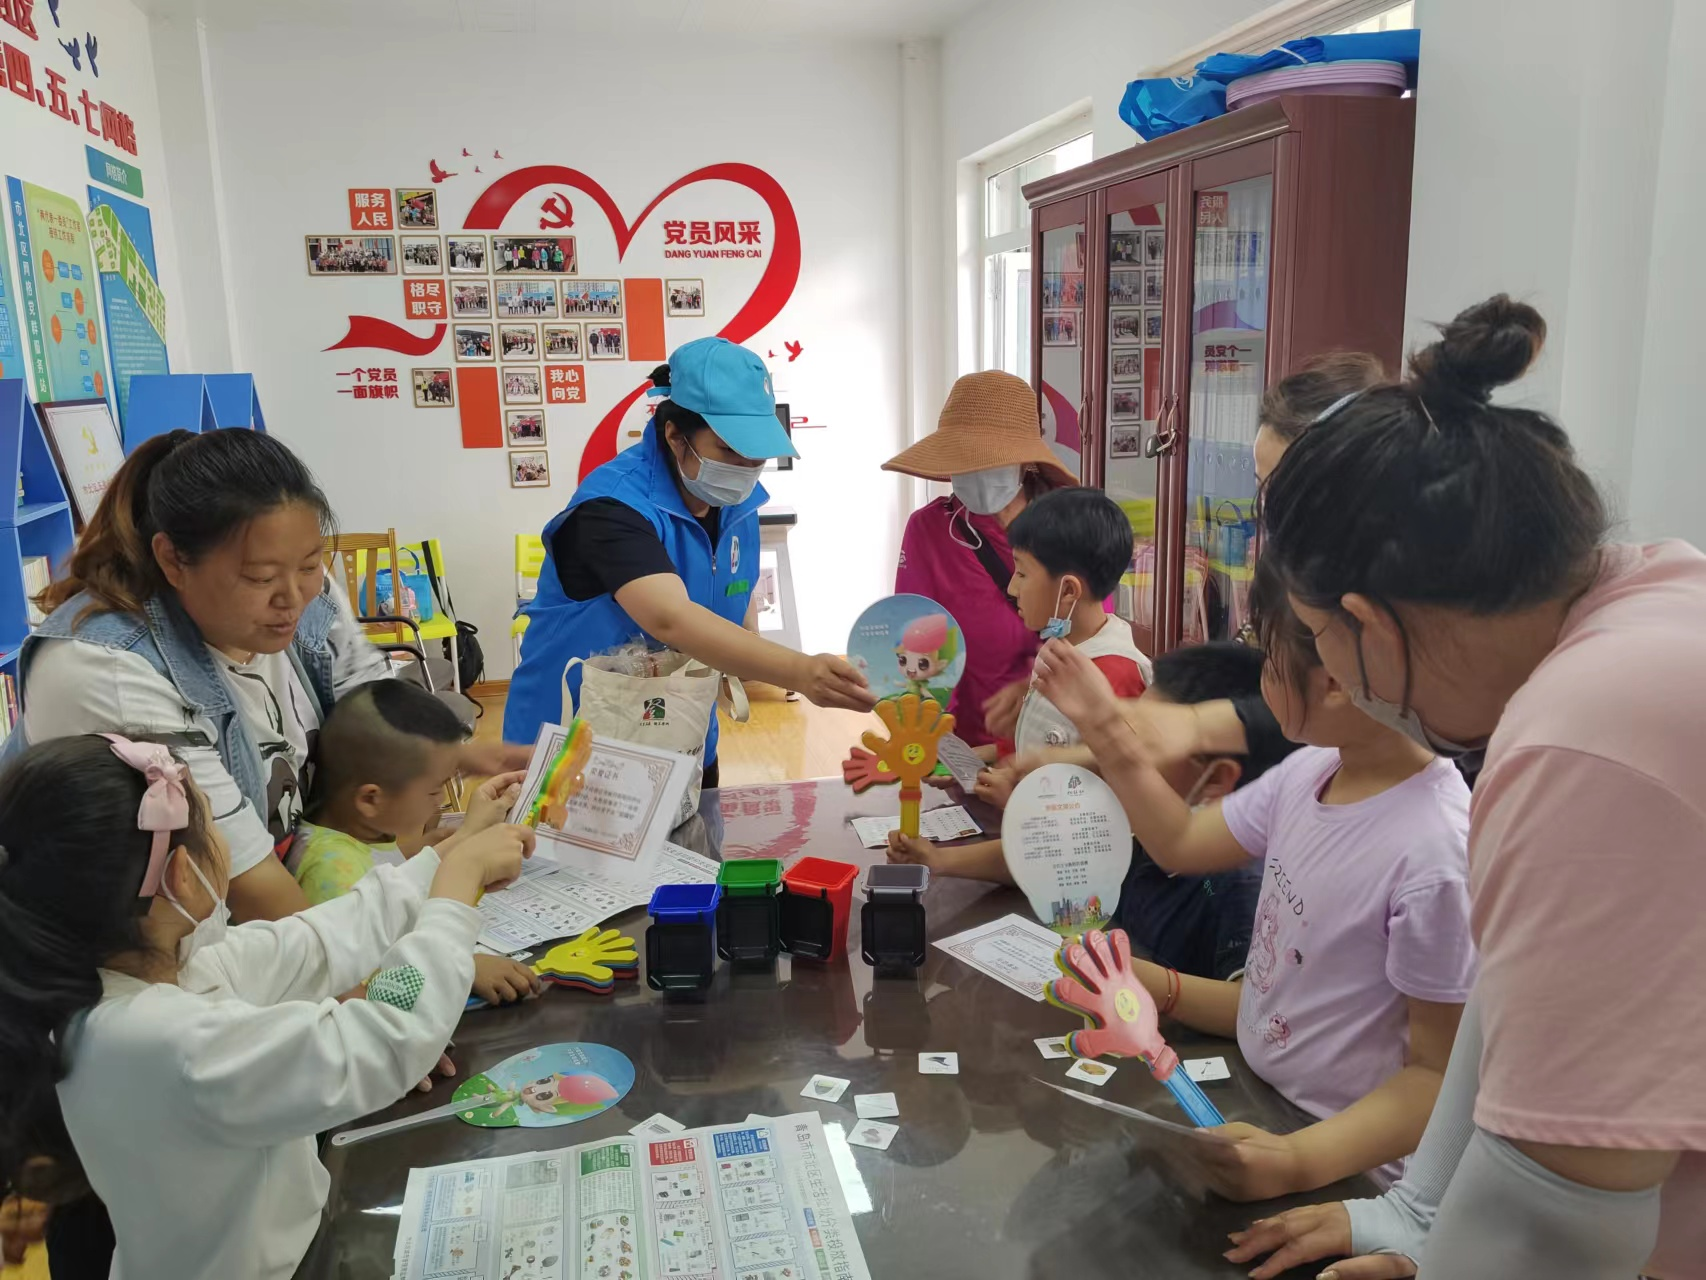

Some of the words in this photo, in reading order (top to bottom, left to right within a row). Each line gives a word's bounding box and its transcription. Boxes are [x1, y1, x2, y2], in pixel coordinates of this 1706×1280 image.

[0, 40, 138, 156] 四、五、七网格
[354, 192, 386, 208] 服务
[357, 211, 388, 227] 人民
[663, 220, 762, 245] 党员风采
[664, 249, 692, 259] DANG
[692, 249, 720, 259] YUAN
[720, 249, 746, 259] FENG
[746, 249, 762, 259] CAI
[411, 301, 442, 316] 职守
[335, 367, 398, 382] 一个党员
[550, 368, 580, 383] 我心
[336, 384, 400, 399] 一面旗帜
[551, 386, 581, 400] 向党
